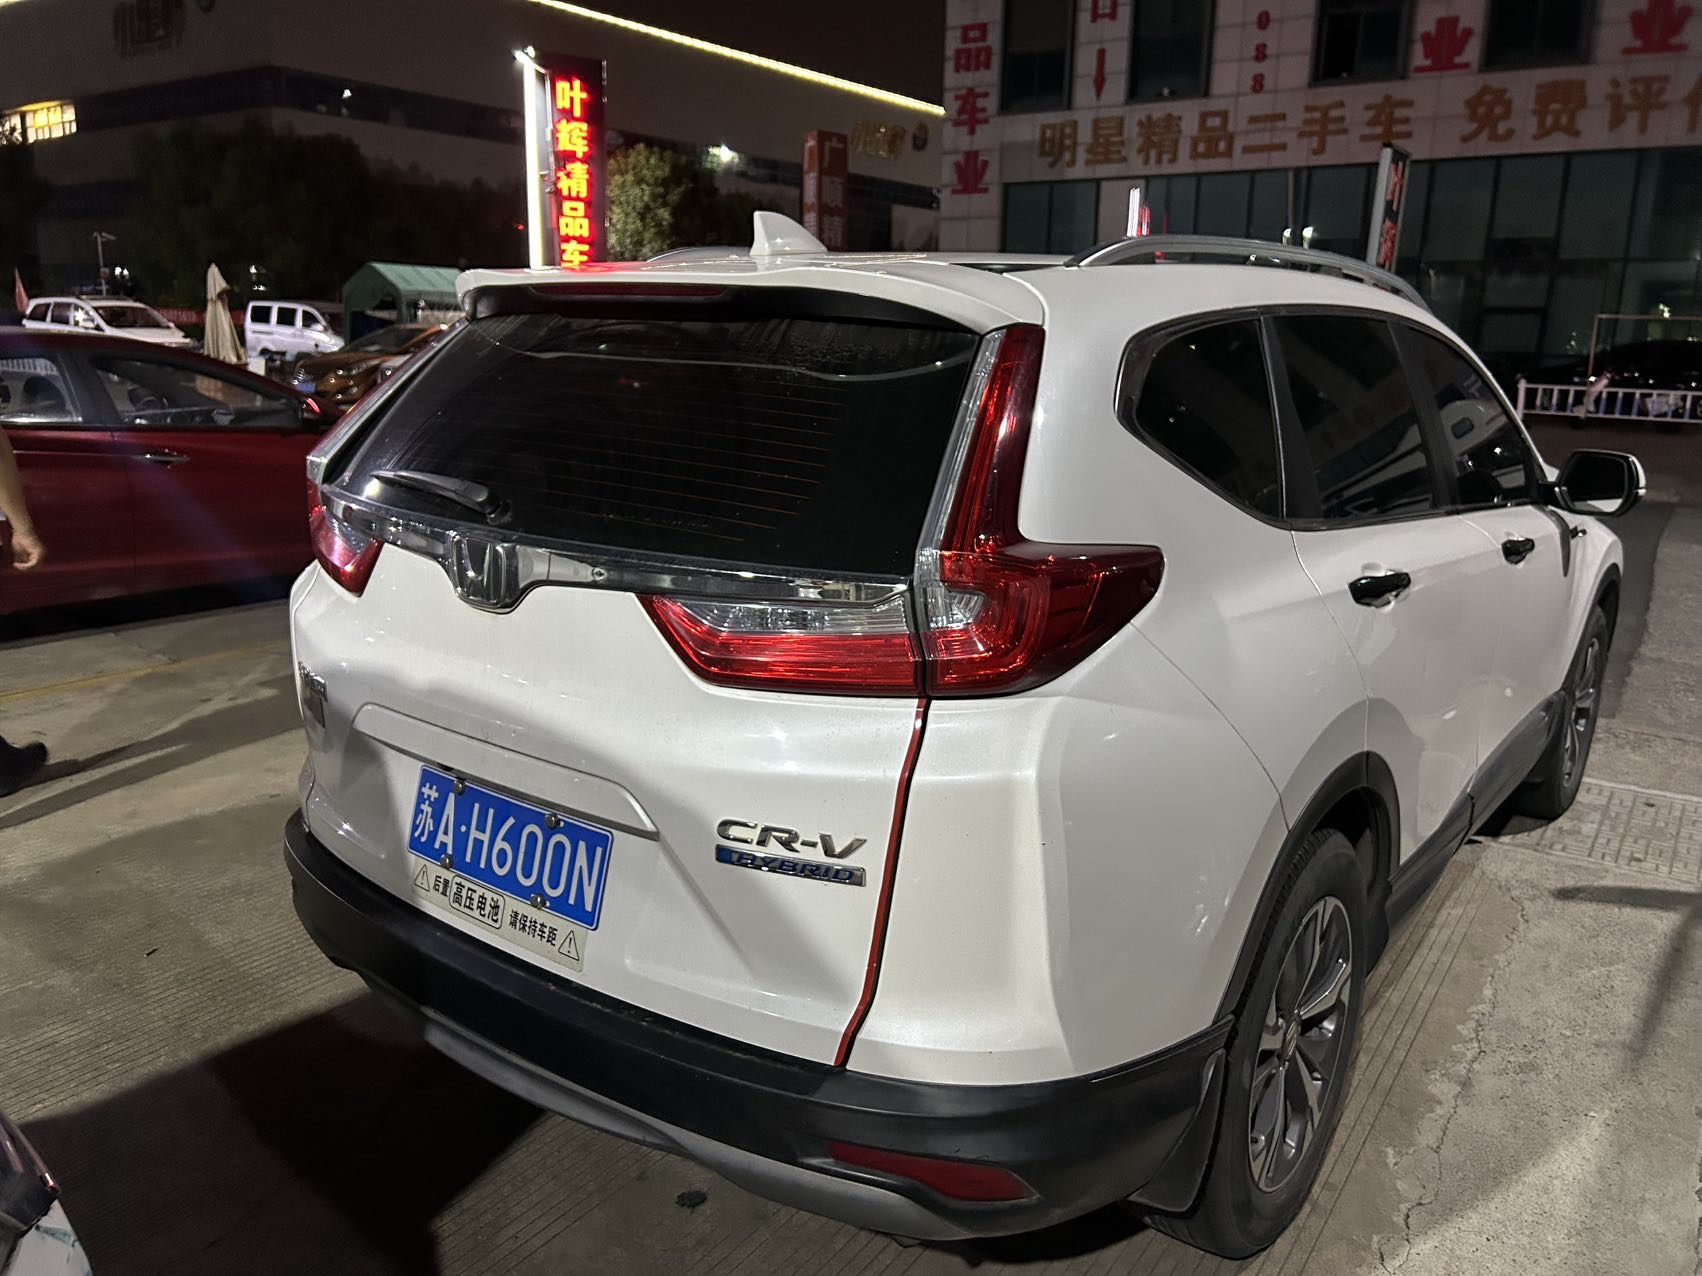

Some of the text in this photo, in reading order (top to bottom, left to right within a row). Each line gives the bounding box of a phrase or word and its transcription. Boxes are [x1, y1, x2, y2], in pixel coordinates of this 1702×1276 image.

[1038, 95, 1416, 168] 明星精品二手车
[555, 78, 590, 270] 叶辉精品车
[716, 818, 868, 860] CR-V
